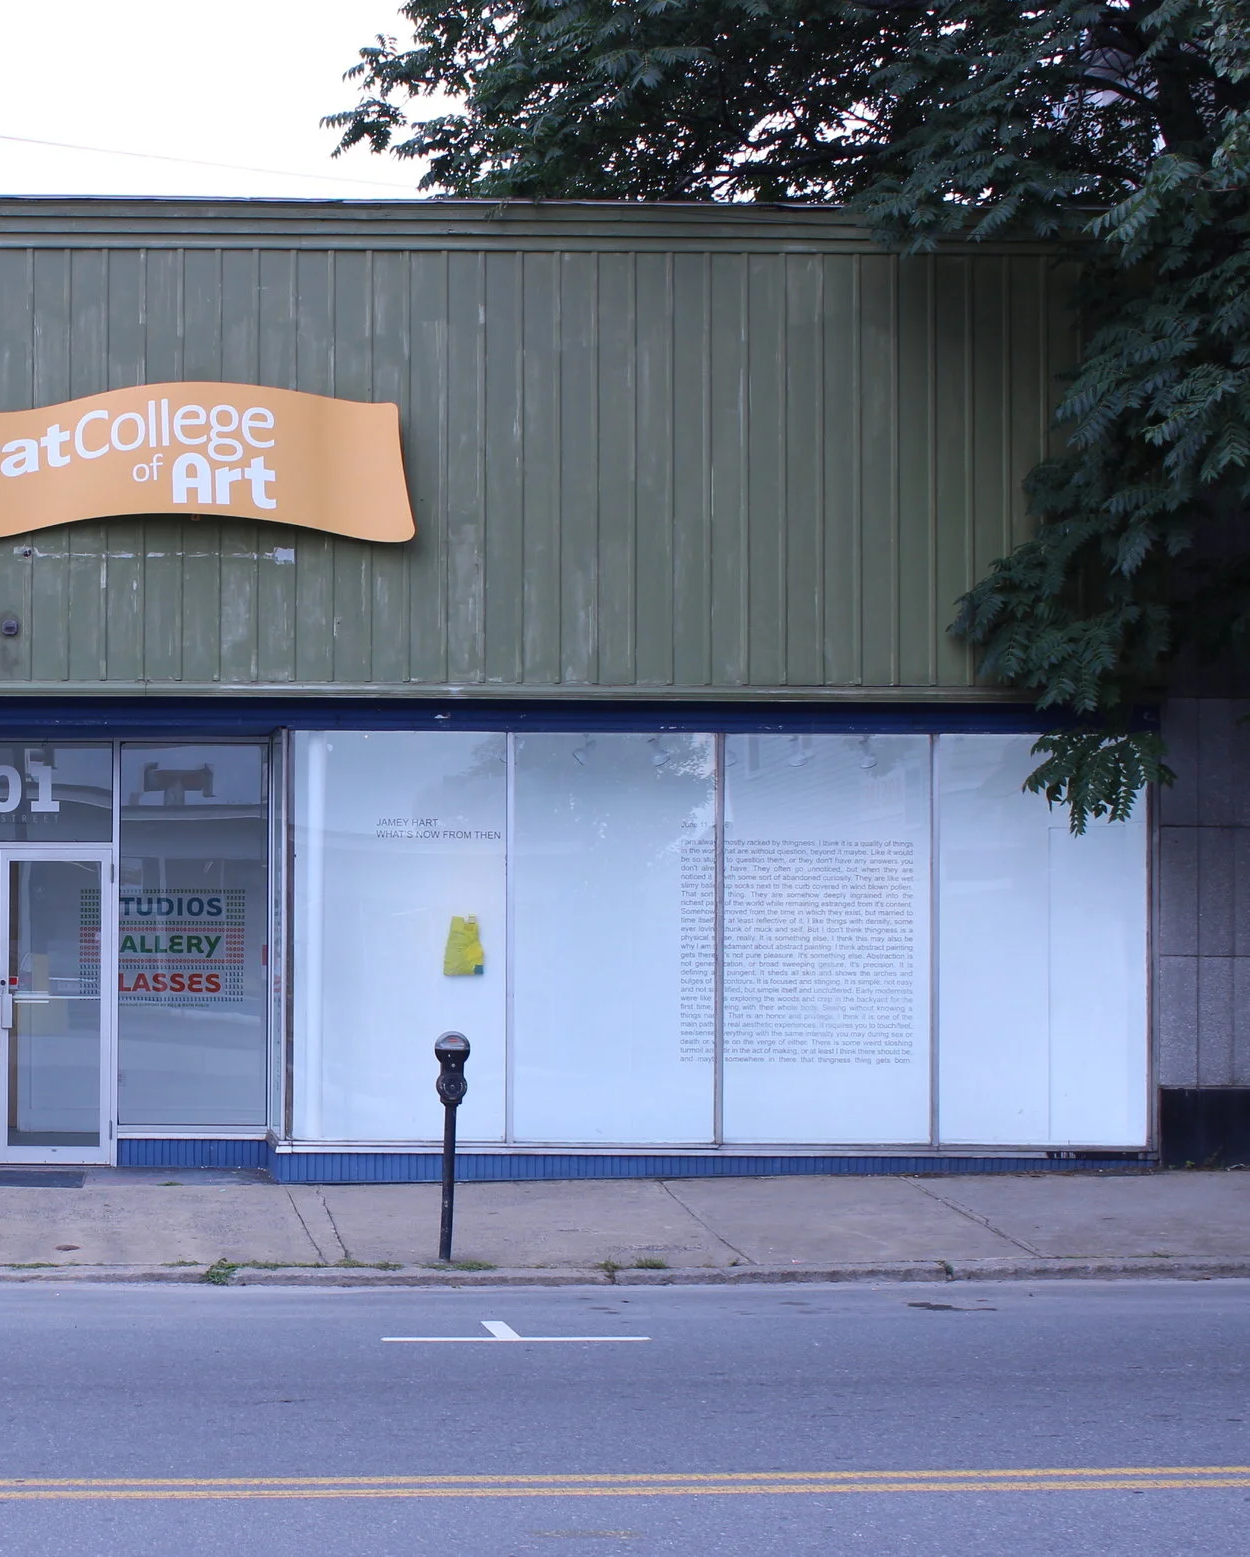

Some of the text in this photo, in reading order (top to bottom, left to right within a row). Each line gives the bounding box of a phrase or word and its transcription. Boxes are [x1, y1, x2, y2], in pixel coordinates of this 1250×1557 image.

[74, 398, 275, 462] College
[132, 451, 277, 510] of Art
[0, 814, 59, 823] STREET
[376, 818, 439, 827] JAMEY HART
[376, 830, 501, 839] WHAT'S NOW FROM THEN
[860, 840, 883, 848] quality
[892, 840, 914, 849] things
[810, 848, 836, 857] beyond
[870, 848, 885, 856] Like
[735, 856, 765, 865] question
[752, 865, 771, 873] They
[883, 866, 898, 875] they
[750, 891, 768, 899] They
[823, 891, 847, 900] deeply
[850, 892, 882, 900] ingrained
[118, 897, 223, 917] TUDIOS
[785, 900, 819, 908] remaining
[820, 900, 856, 909] estranged
[780, 908, 795, 916] time
[827, 909, 843, 917] they
[864, 927, 898, 935] thingness
[680, 934, 709, 942] physical
[774, 934, 810, 943] something
[120, 935, 222, 958] ALLERY
[885, 944, 913, 953] painting
[680, 952, 696, 960] gets
[782, 961, 815, 969] sweeping
[680, 968, 708, 977] defining
[118, 973, 222, 993] LASSES
[680, 977, 704, 986] bulges
[756, 986, 779, 995] simple
[780, 986, 797, 994] itself
[730, 995, 762, 1003] exploring
[876, 1005, 906, 1013] knowing
[680, 1012, 701, 1020] things
[884, 1039, 913, 1048] sloshing
[724, 1055, 765, 1063] somewhere
[817, 1056, 851, 1065] thingness
[855, 1056, 872, 1065] thing
[876, 1057, 891, 1065] gets
